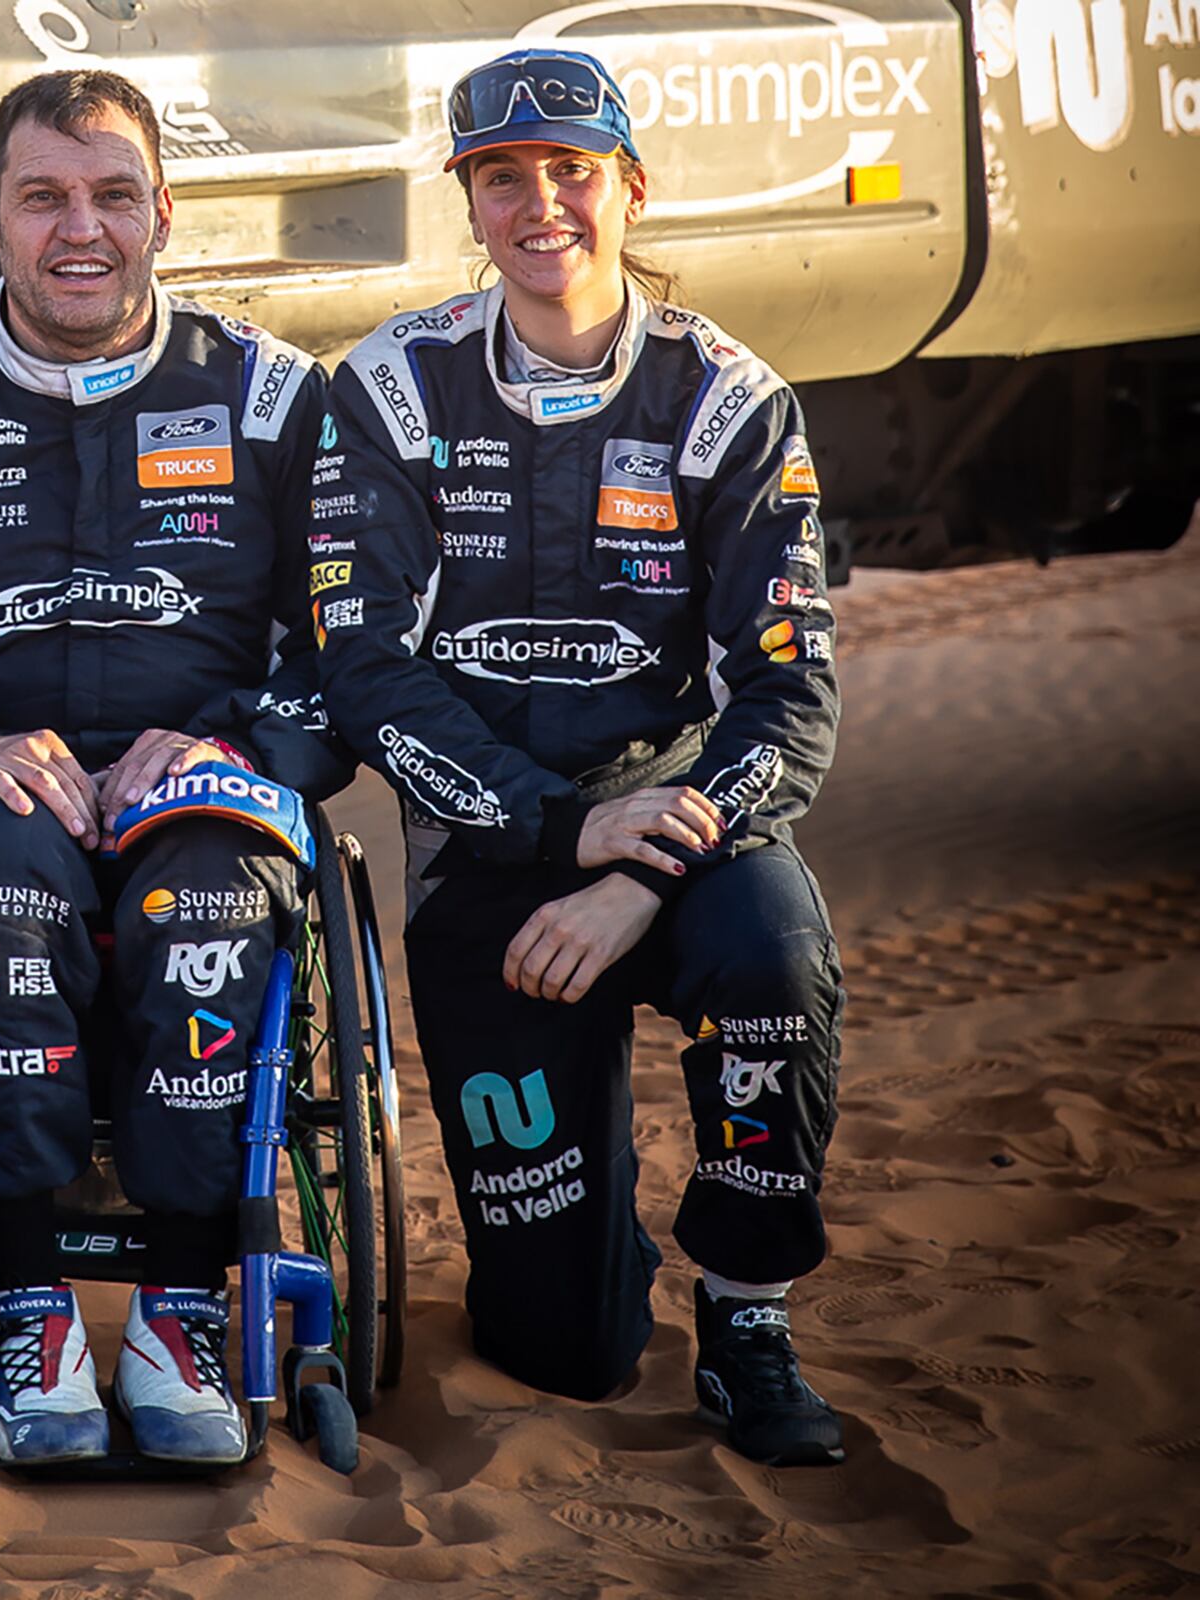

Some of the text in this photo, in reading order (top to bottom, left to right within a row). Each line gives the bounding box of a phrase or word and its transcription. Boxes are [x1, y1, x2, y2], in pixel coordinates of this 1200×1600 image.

[618, 42, 931, 138] osimplex
[253, 353, 292, 420] sparco
[375, 363, 425, 443] sparco
[161, 418, 206, 439] Ford
[691, 384, 748, 459] sparco
[155, 459, 217, 476] TRUCKS
[624, 454, 664, 478] Ford
[437, 485, 513, 506] Andorra
[613, 499, 669, 519] TRUCKS
[442, 531, 508, 549] SUNRISE
[432, 631, 662, 670] Guidosimplex
[140, 771, 280, 813] kimoa
[179, 888, 267, 909] SUNRISE
[719, 1015, 808, 1034] SUNRISE
[146, 1067, 248, 1097] Andorr
[469, 1145, 585, 1196] Andorra
[480, 1179, 587, 1226] la Vella
